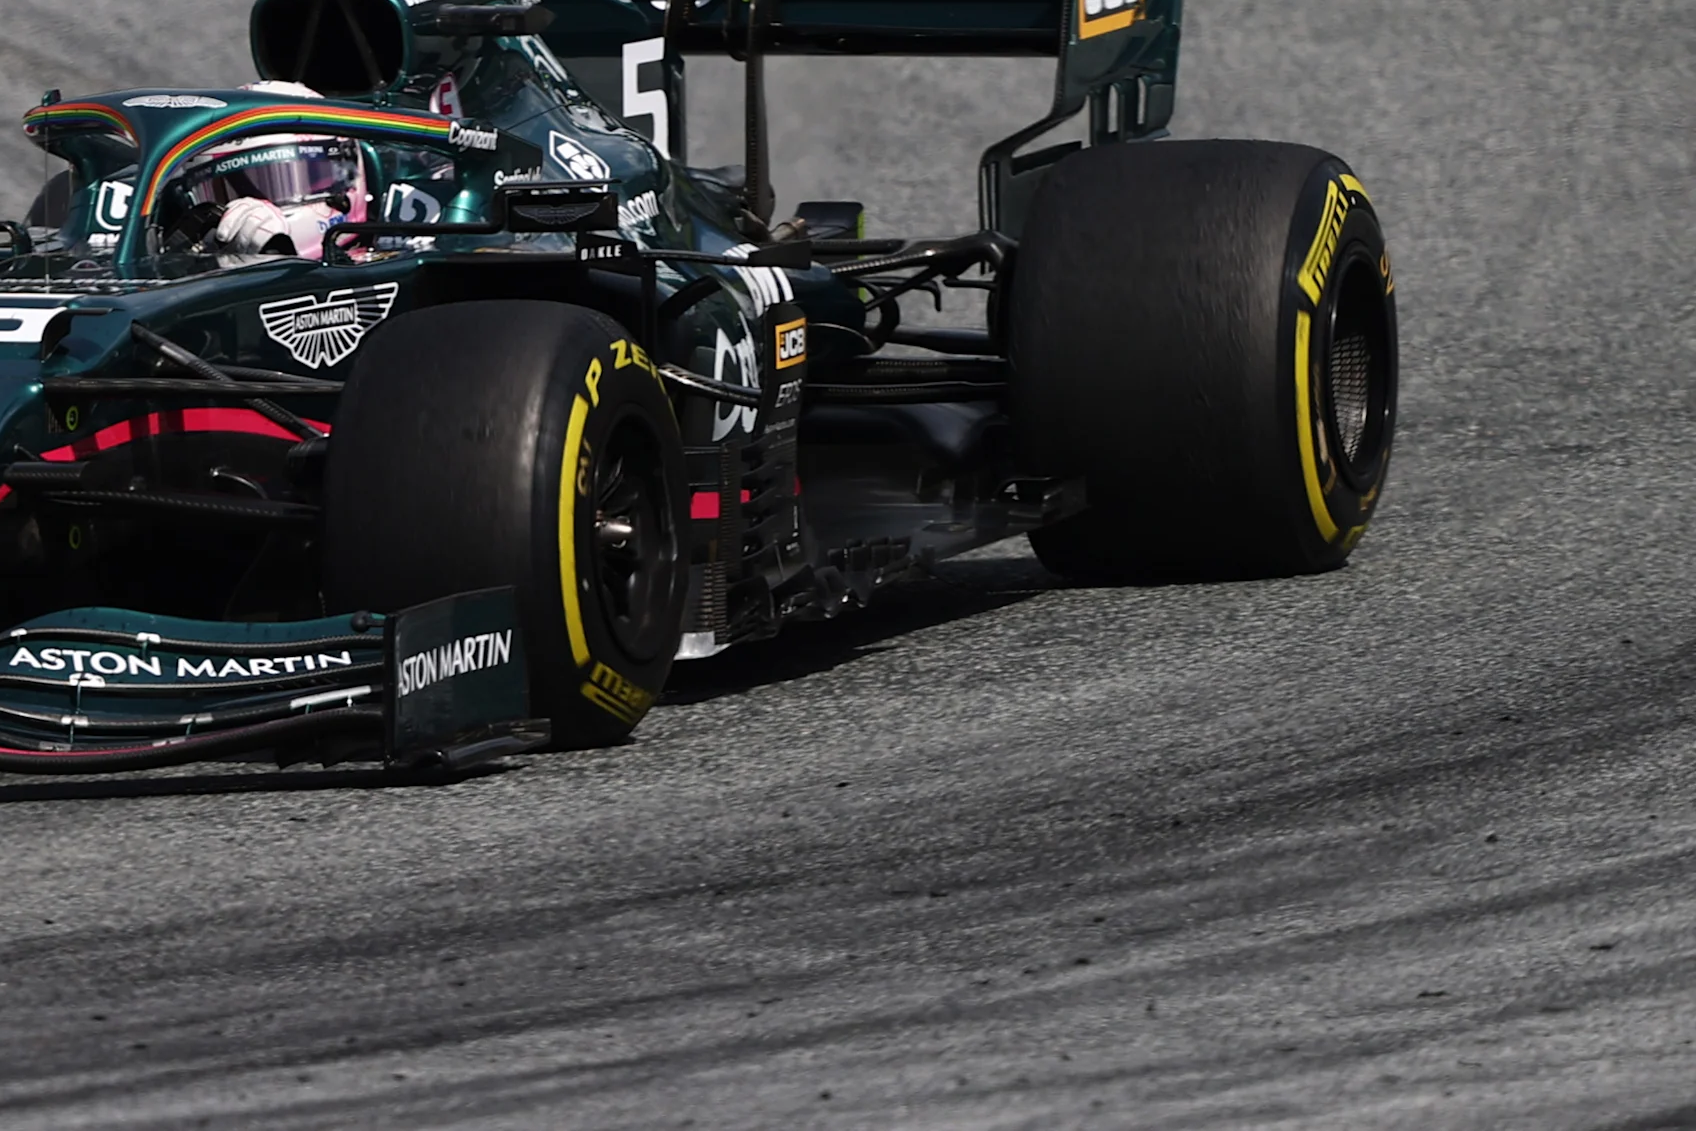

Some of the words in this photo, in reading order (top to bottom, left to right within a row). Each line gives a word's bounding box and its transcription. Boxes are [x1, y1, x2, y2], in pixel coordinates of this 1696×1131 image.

[622, 37, 671, 161] 5
[448, 120, 498, 152] Cognizant
[215, 156, 249, 174] ASTON
[251, 148, 295, 164] MARTIN
[295, 313, 319, 330] ASTON
[320, 307, 354, 326] MARTIN
[780, 327, 805, 359] JCB
[9, 647, 161, 678] ASTON
[177, 650, 352, 678] MARTIN
[397, 648, 437, 698] ASTON
[439, 629, 512, 681] MARTIN
